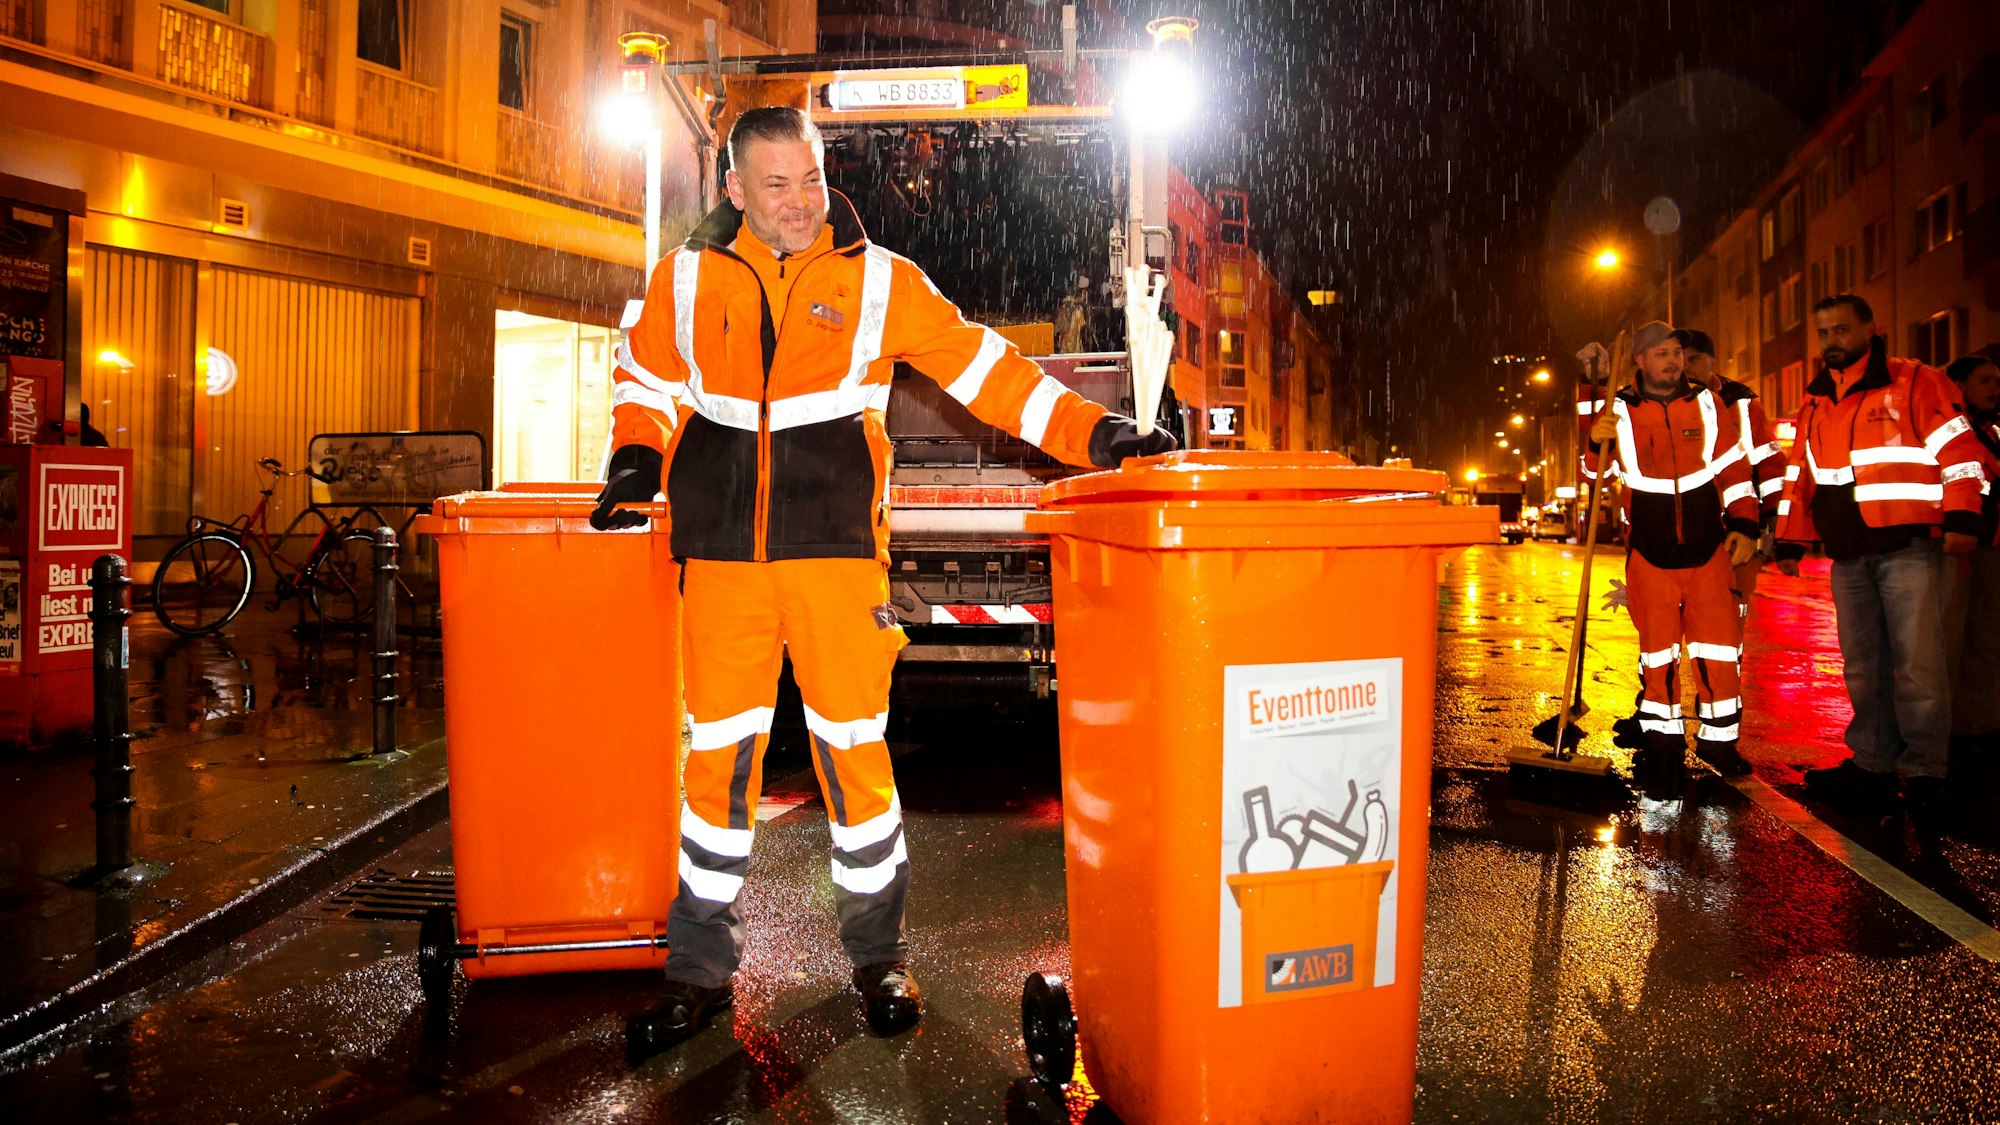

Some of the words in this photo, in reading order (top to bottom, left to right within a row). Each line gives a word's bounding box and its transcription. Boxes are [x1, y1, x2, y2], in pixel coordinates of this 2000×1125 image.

[852, 84, 863, 102] K
[878, 84, 901, 101] WB
[907, 83, 953, 101] 8833
[14, 258, 51, 272] KIRCHE
[47, 483, 117, 531] EXPRESS
[48, 563, 77, 586] Bei
[40, 594, 78, 617] liest
[38, 621, 94, 648] EXPRE
[1248, 681, 1377, 725] Eventtonne
[1299, 951, 1348, 983] AWB
